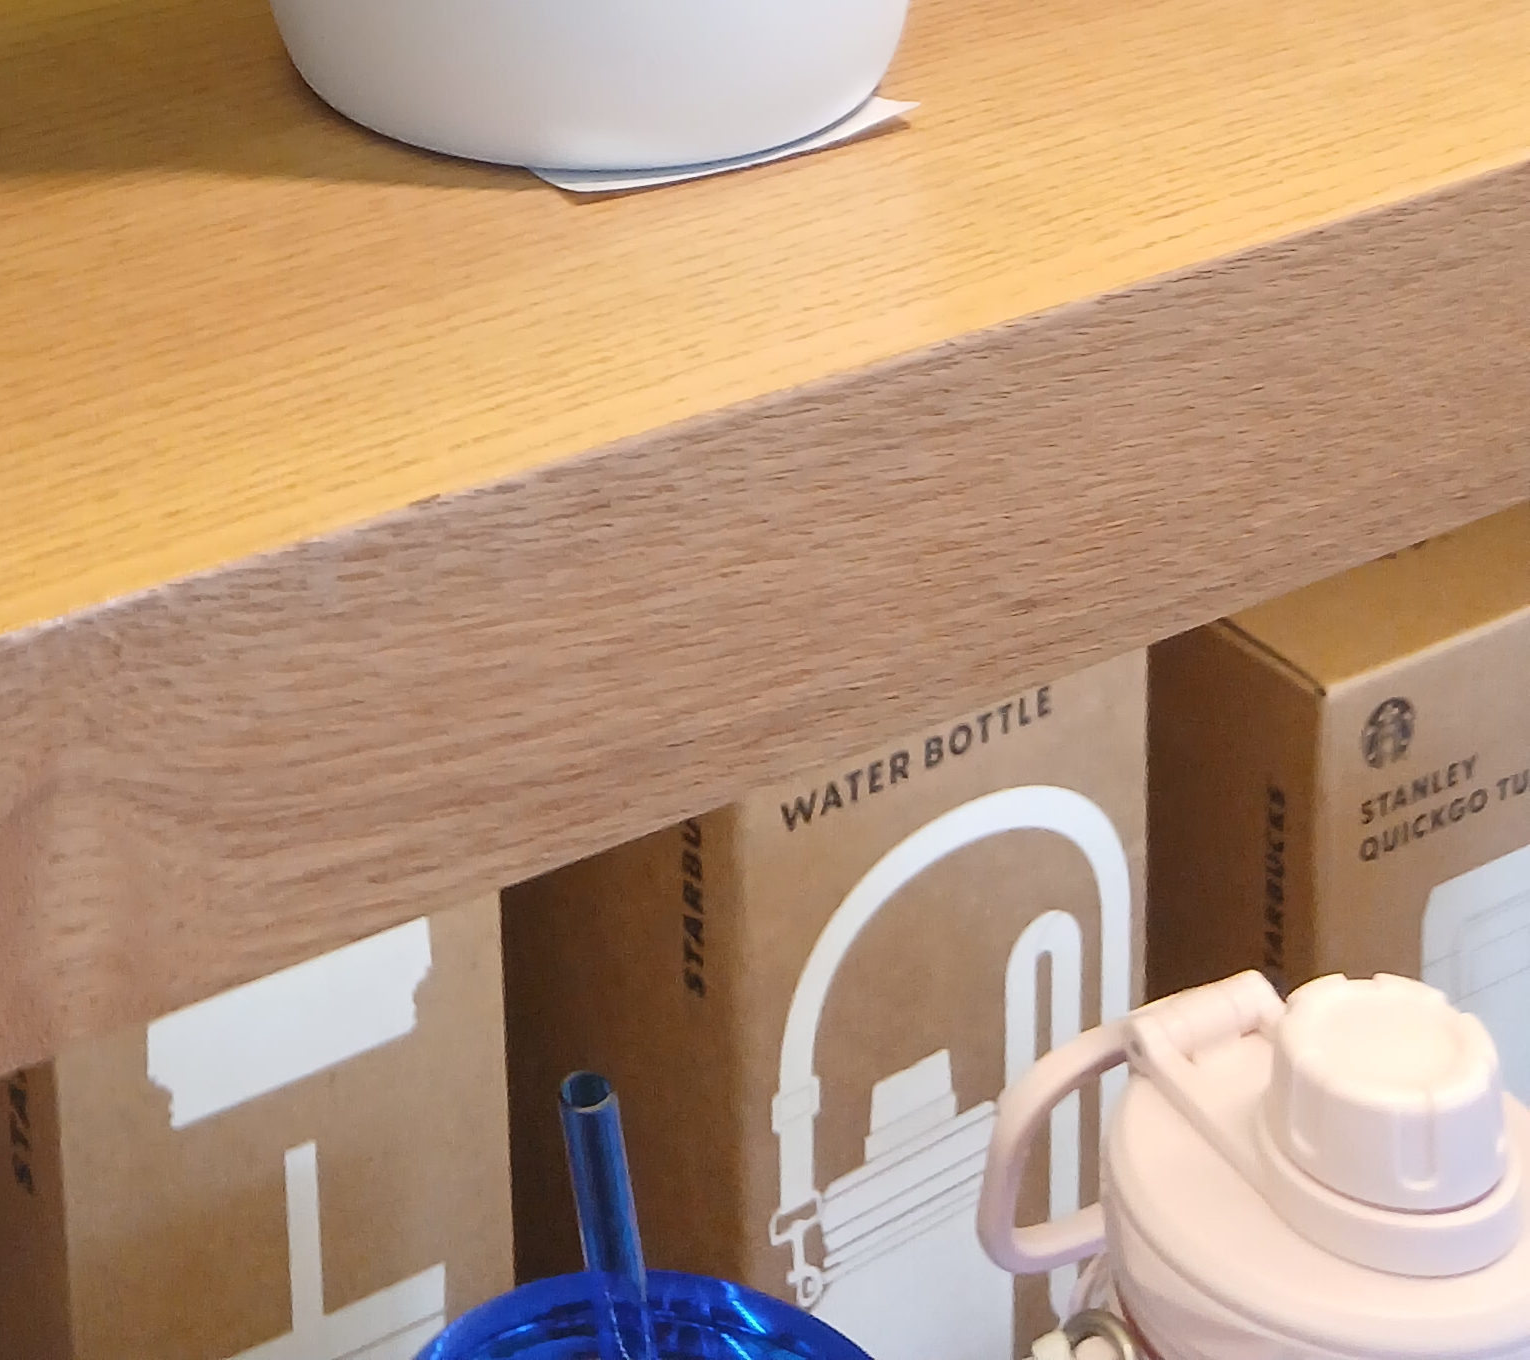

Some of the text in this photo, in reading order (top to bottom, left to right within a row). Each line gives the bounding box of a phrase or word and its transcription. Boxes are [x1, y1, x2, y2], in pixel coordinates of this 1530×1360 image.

[780, 686, 1052, 832] WATER BOTTLE
[1360, 752, 1479, 825] STANLEY
[1357, 788, 1489, 862] QUICKGO
